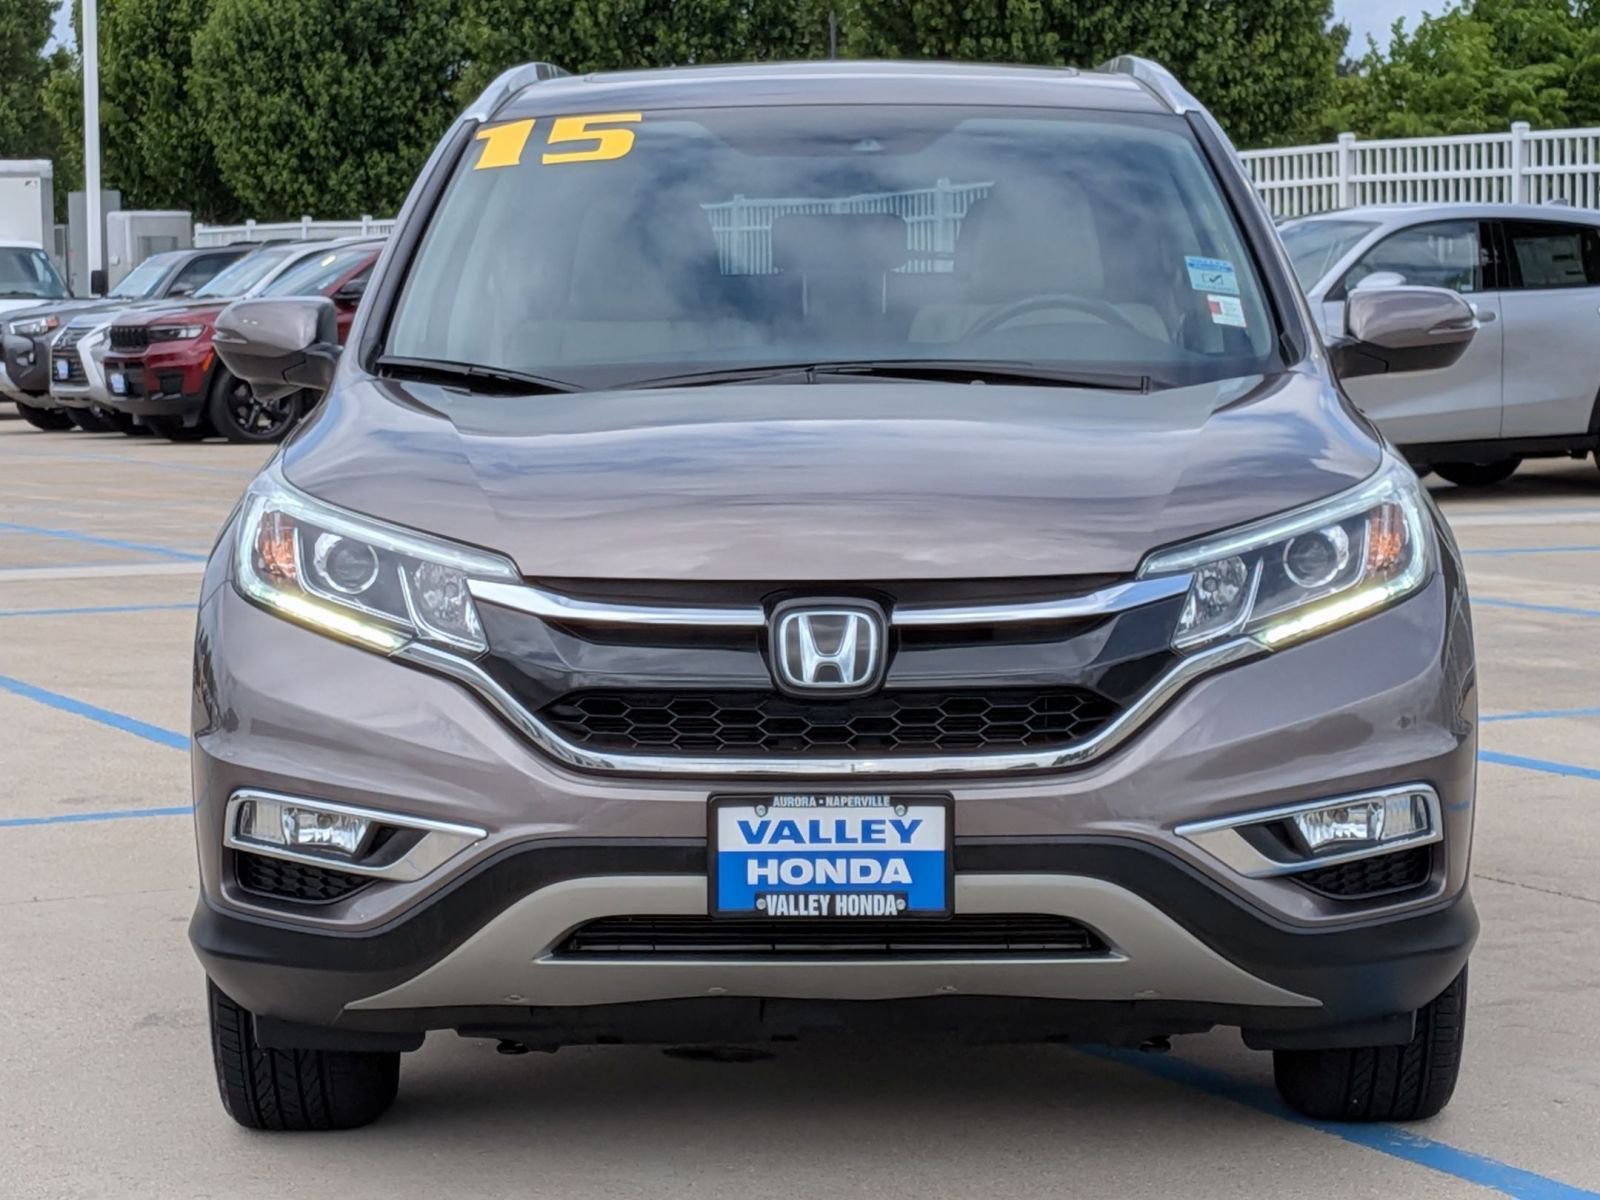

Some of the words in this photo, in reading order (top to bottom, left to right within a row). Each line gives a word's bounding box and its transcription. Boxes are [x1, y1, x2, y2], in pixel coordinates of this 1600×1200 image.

[473, 111, 643, 170] 15
[773, 795, 817, 807] AURORA
[826, 795, 890, 807] NAPERVILLE
[736, 819, 923, 845] VALLEY
[747, 858, 913, 885] HONDA
[767, 894, 831, 916] VALLEY
[835, 894, 898, 916] HONDA
